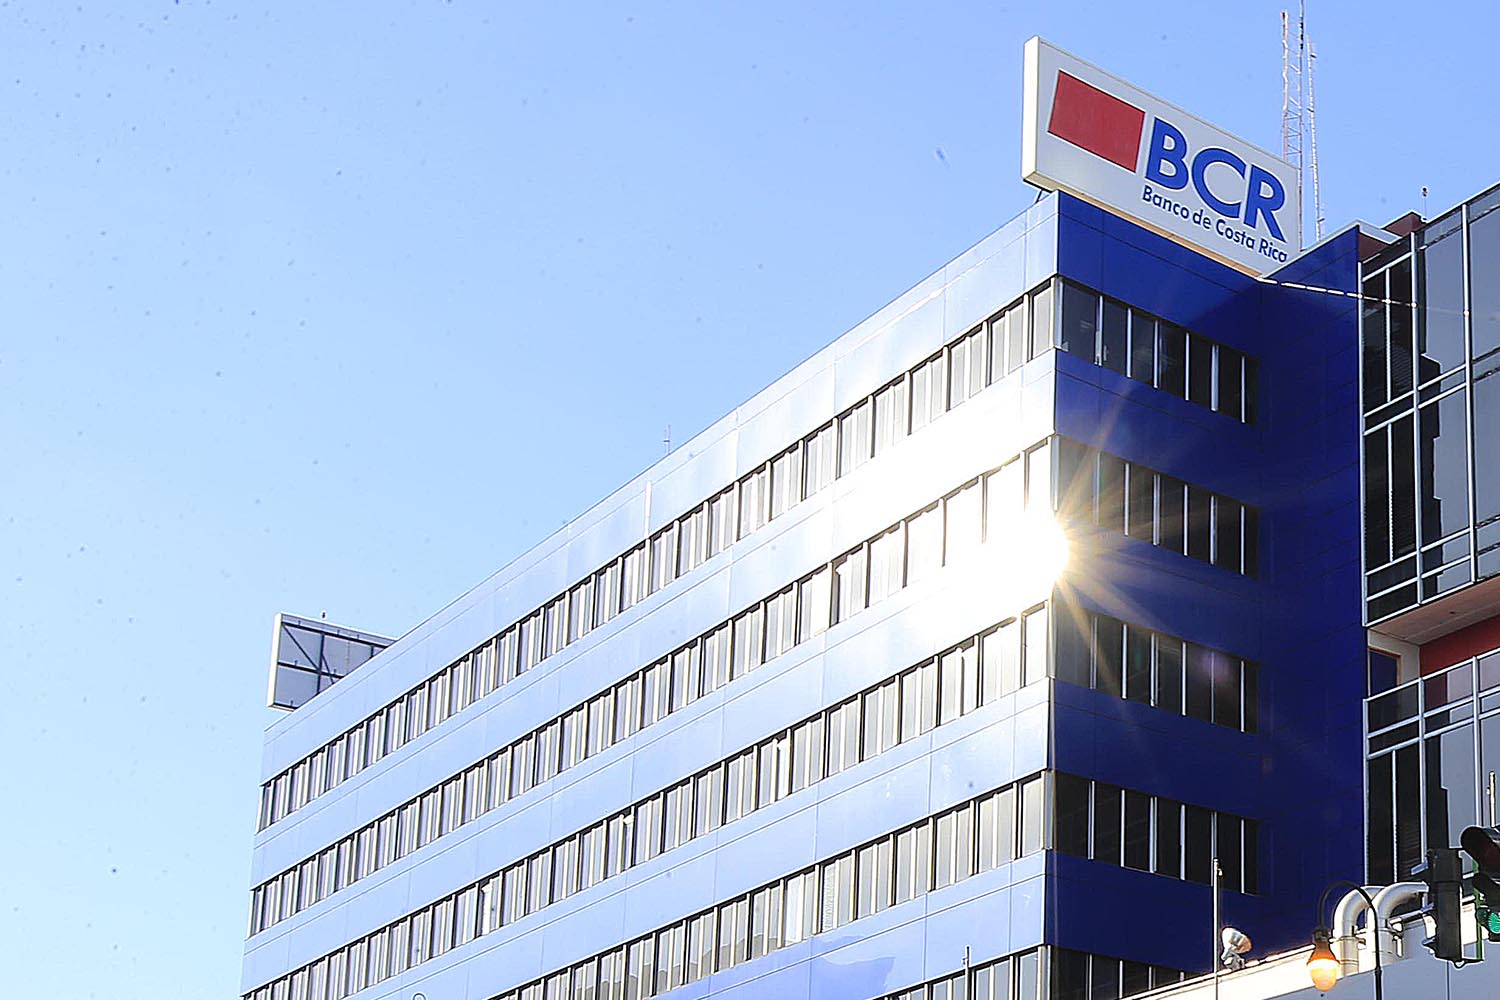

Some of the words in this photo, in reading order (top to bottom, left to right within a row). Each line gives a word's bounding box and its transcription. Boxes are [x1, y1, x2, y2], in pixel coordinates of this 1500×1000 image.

[1143, 185, 1189, 220] Banco
[1193, 208, 1212, 230] de
[1216, 219, 1255, 250] Costa
[1258, 236, 1288, 263] Rica
[1145, 116, 1287, 243] BCR
